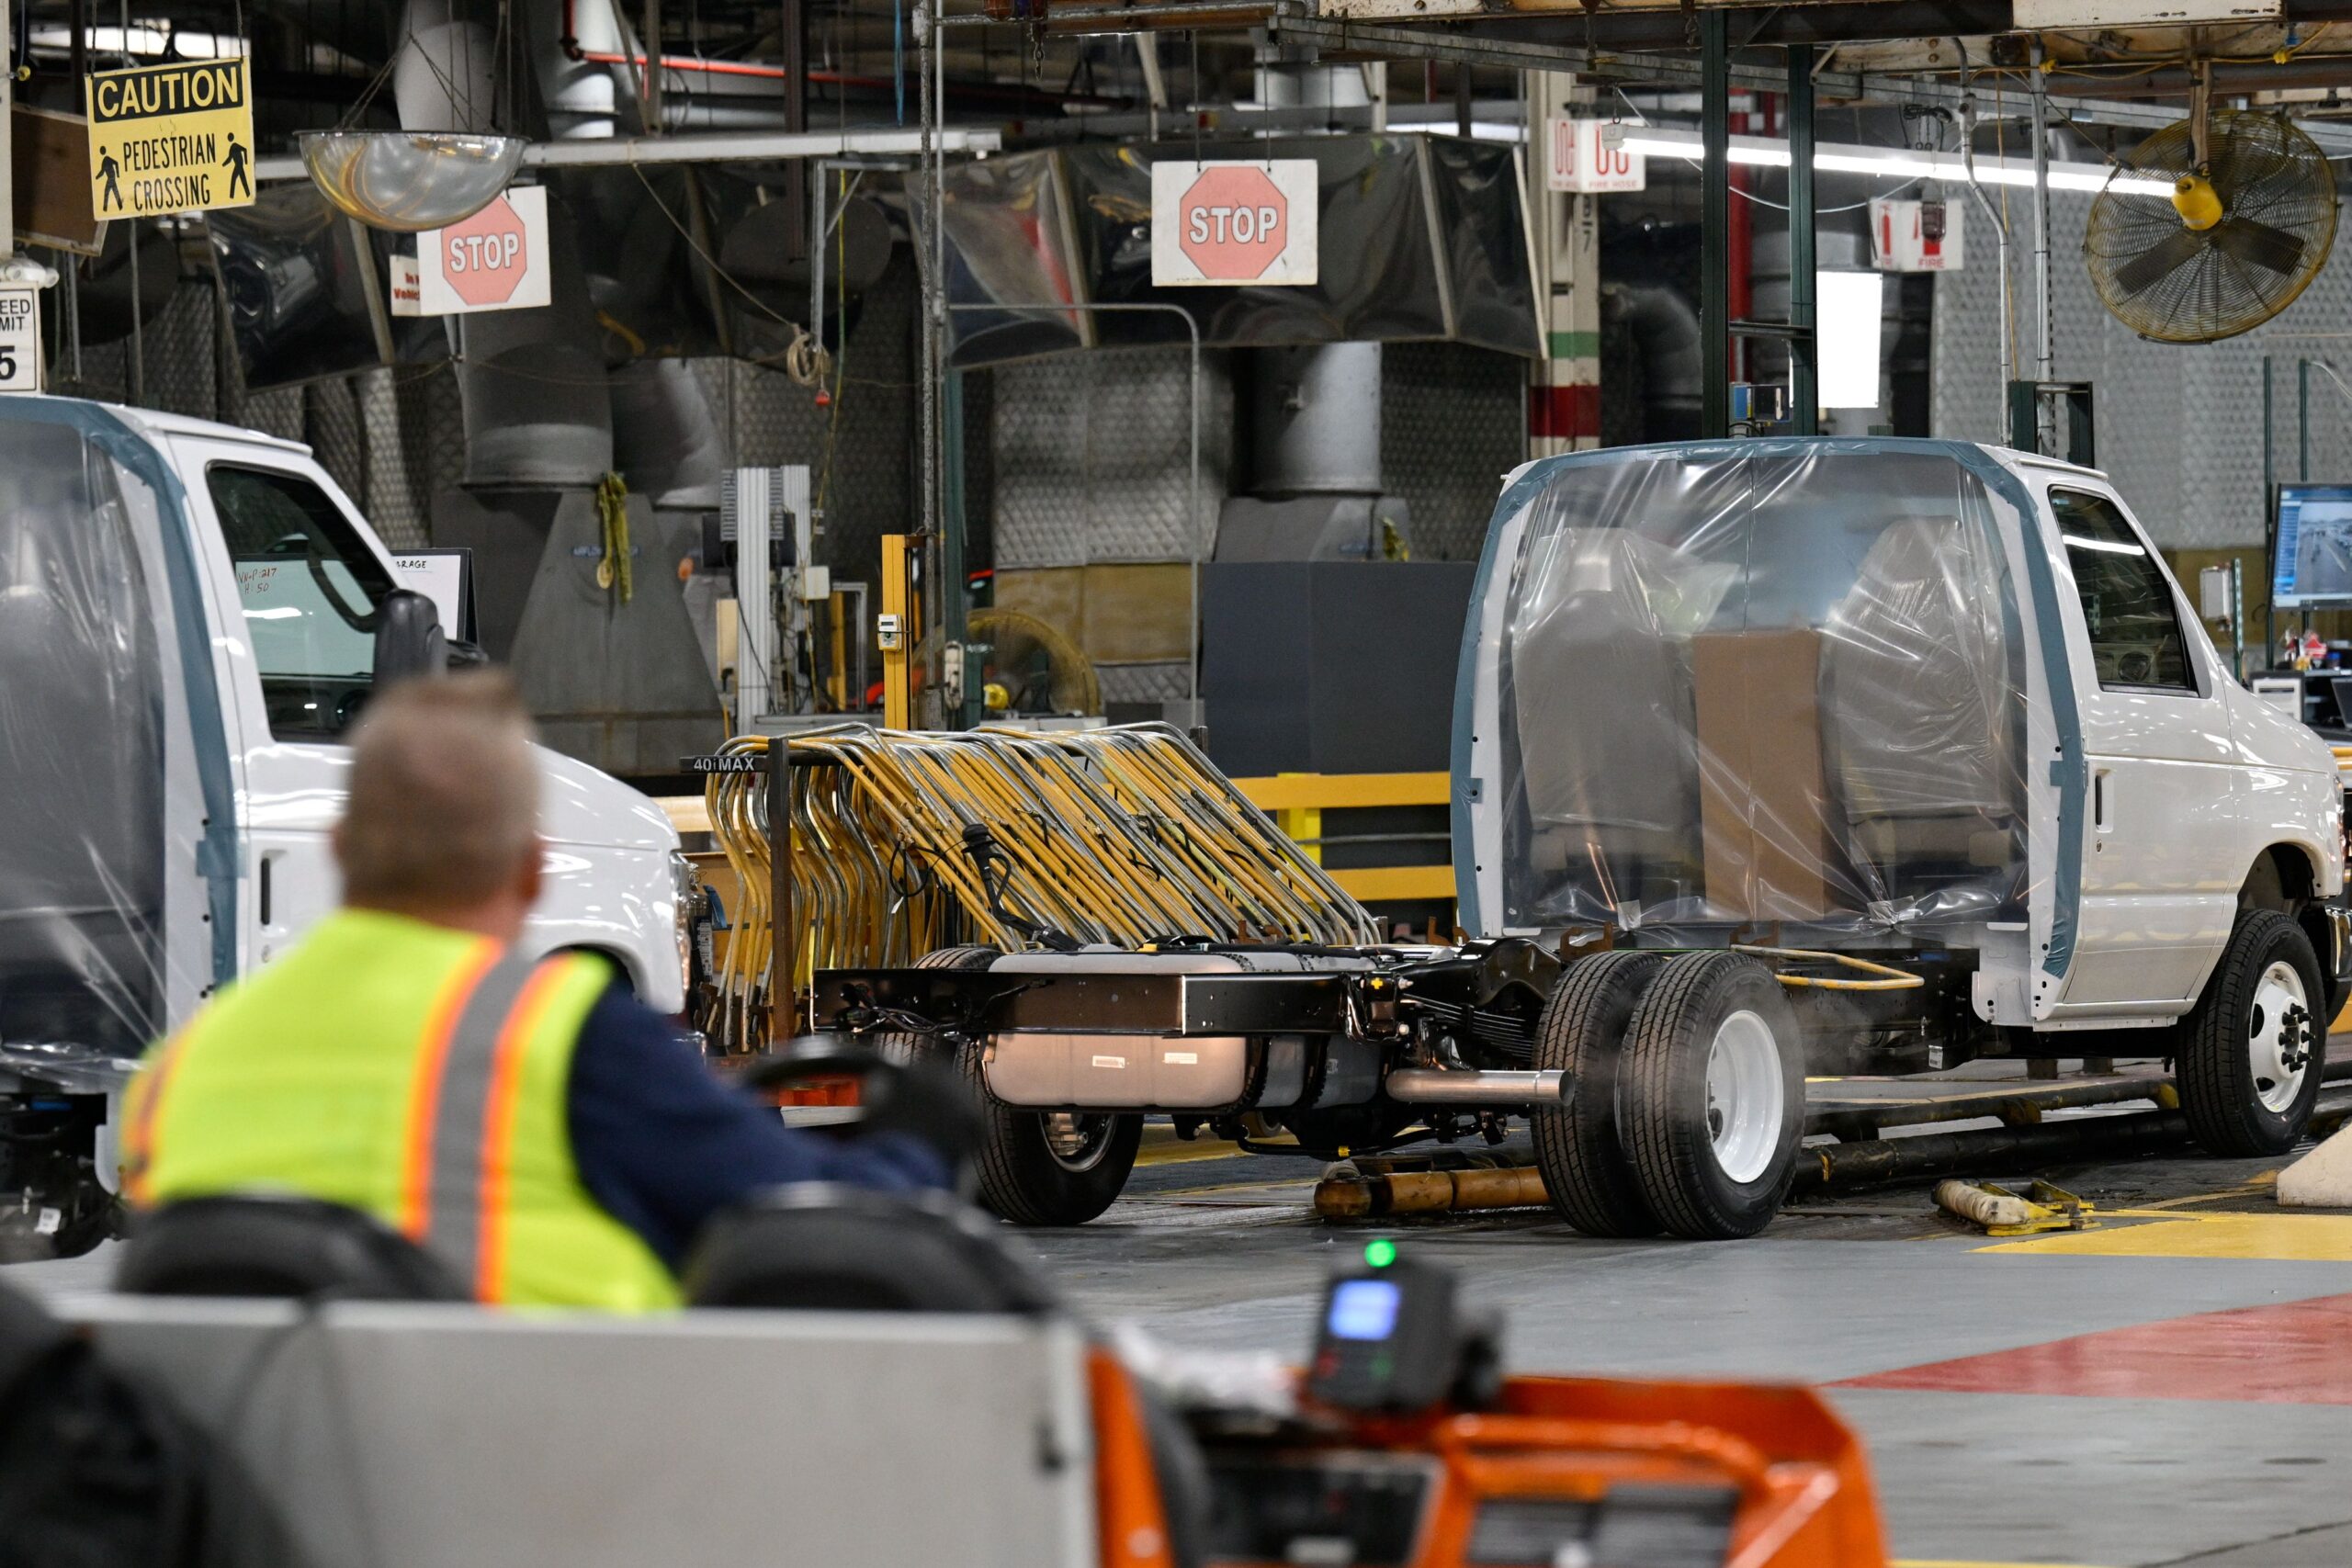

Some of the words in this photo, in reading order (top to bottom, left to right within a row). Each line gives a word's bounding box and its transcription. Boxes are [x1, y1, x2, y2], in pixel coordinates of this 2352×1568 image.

[97, 66, 239, 118] CAUTION
[123, 133, 216, 173] PEDESTRIAN
[133, 174, 210, 212] CROSSING
[1188, 206, 1279, 244] STOP
[449, 232, 520, 273] STOP
